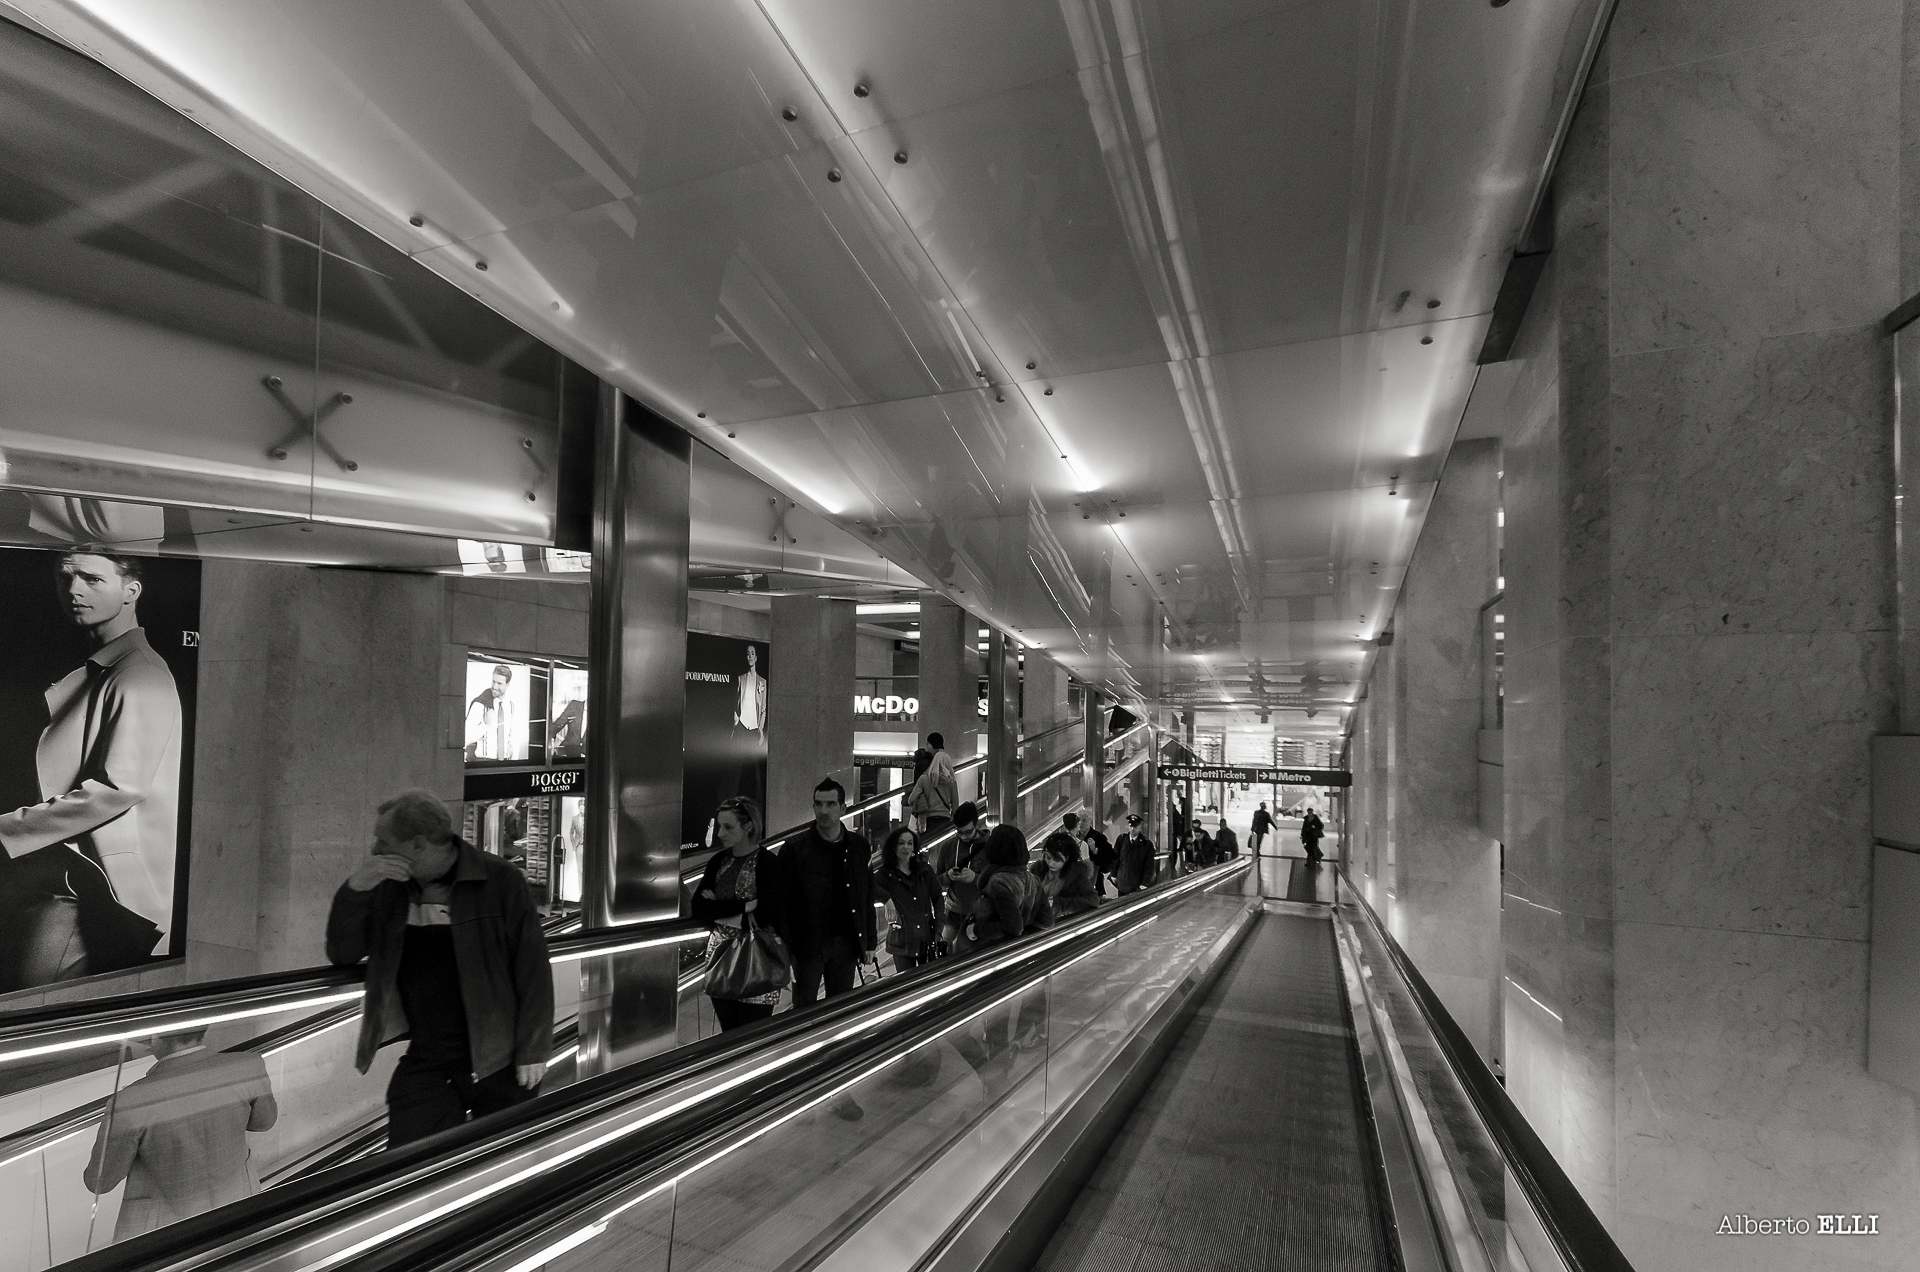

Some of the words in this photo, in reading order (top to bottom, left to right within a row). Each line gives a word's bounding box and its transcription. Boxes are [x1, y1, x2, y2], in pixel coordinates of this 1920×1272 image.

[855, 757, 879, 766] agagli
[530, 771, 577, 787] BOGGI
[1180, 768, 1219, 780] Biglietti
[1219, 769, 1247, 780] Tickets
[1278, 771, 1312, 782] Metro
[541, 785, 570, 793] MILANO
